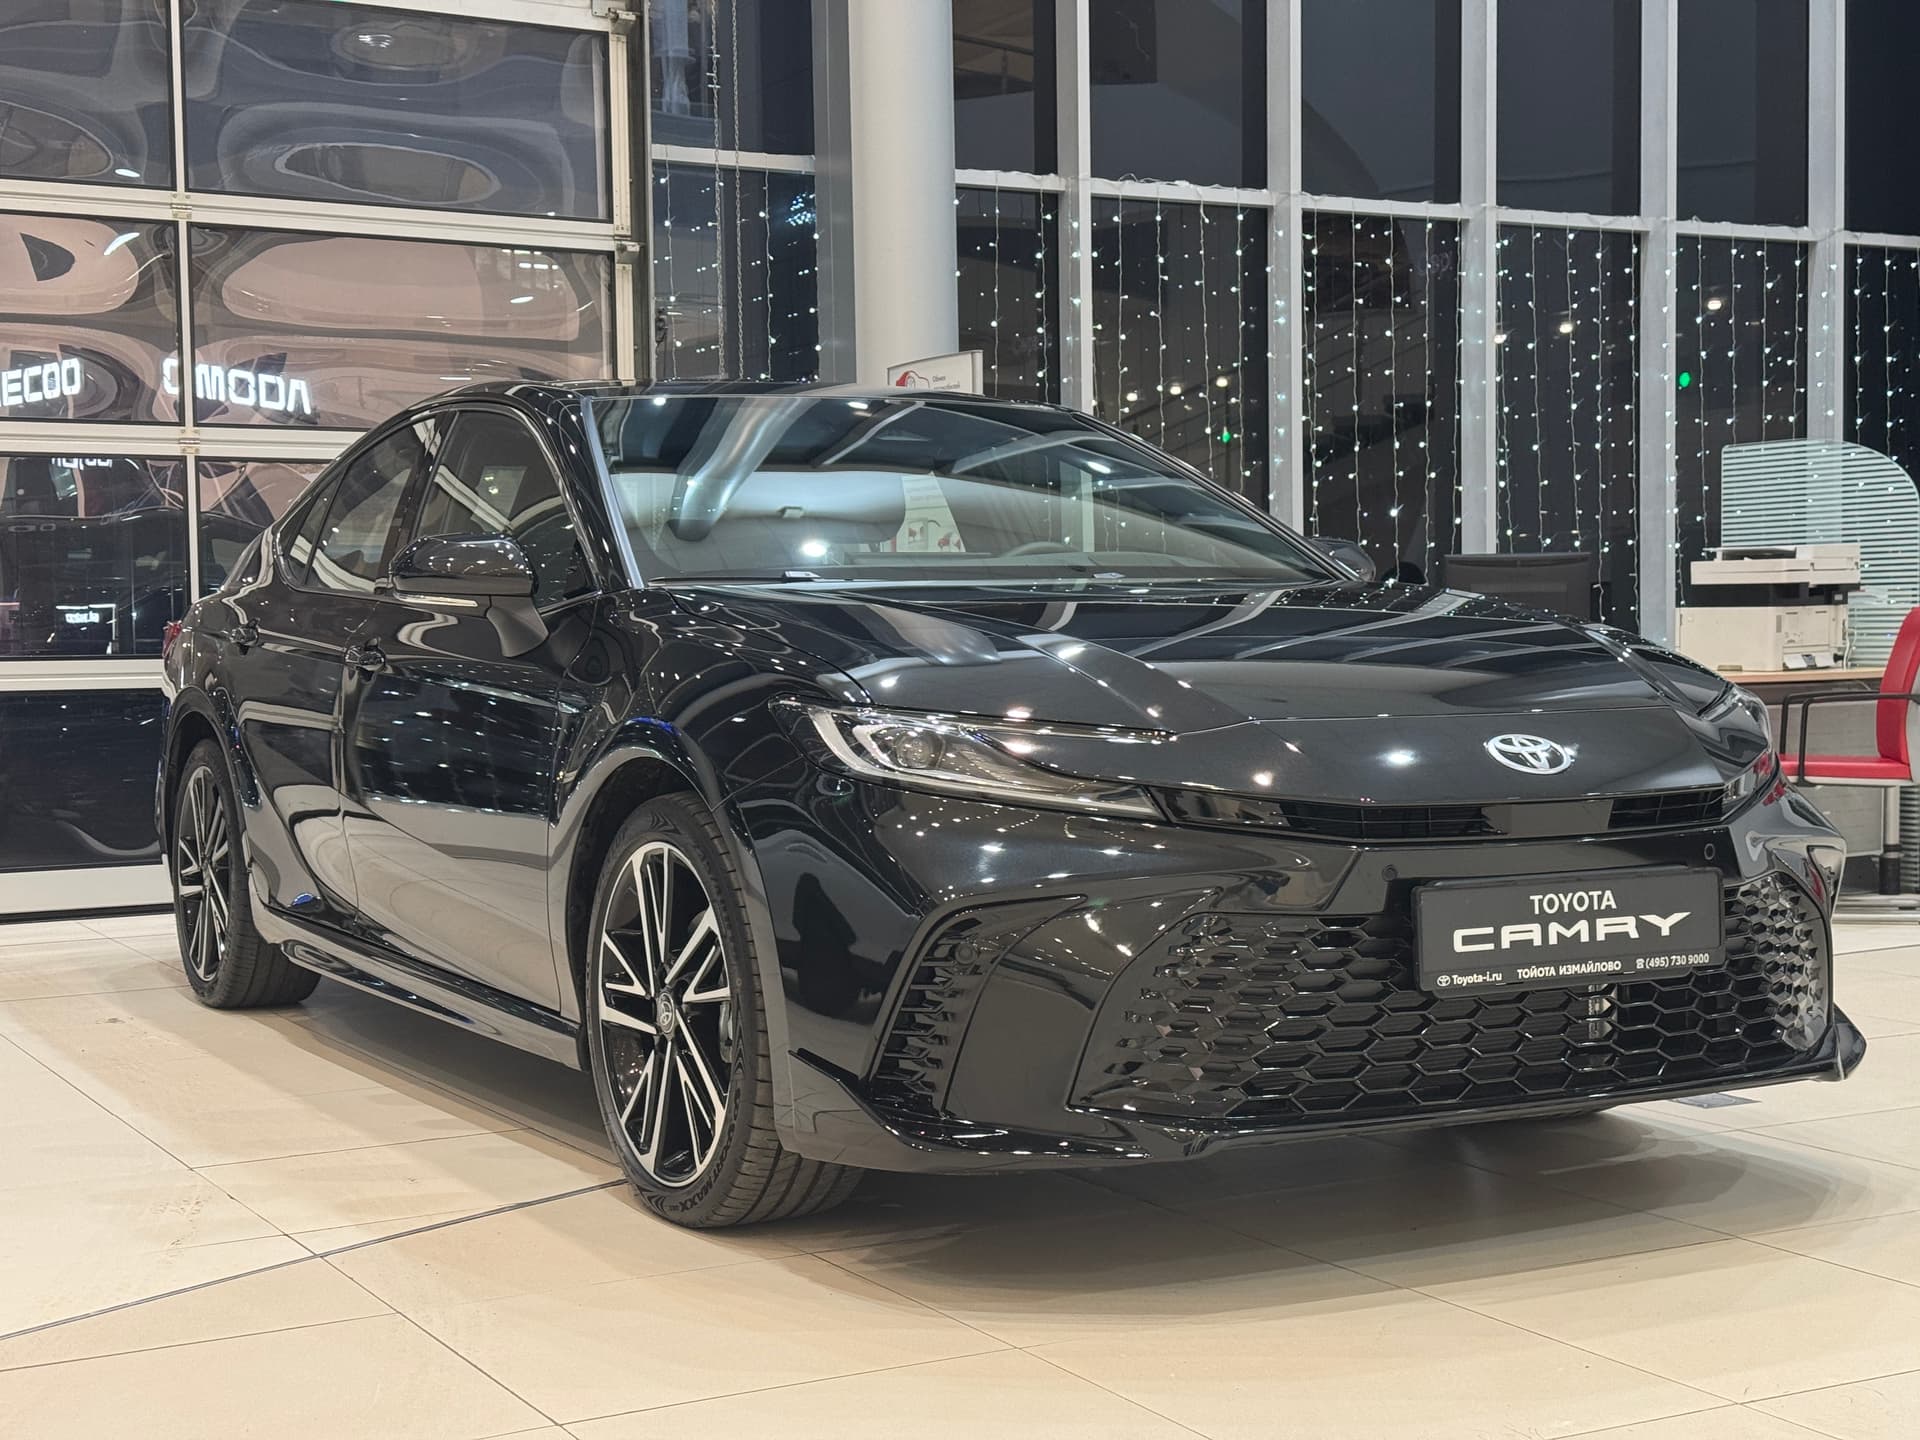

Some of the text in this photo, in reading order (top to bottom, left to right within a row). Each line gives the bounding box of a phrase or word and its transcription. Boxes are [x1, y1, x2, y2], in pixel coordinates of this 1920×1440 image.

[0, 358, 80, 407] ECOO
[1529, 890, 1617, 915] TOYOTA
[1453, 911, 1691, 953] CAMRY
[1517, 961, 1622, 979] ТОЙОТА ИЗМАЙЛОВО
[1645, 953, 1710, 969] (495) 730 9000
[1452, 971, 1502, 987] Toyota-i.ru
